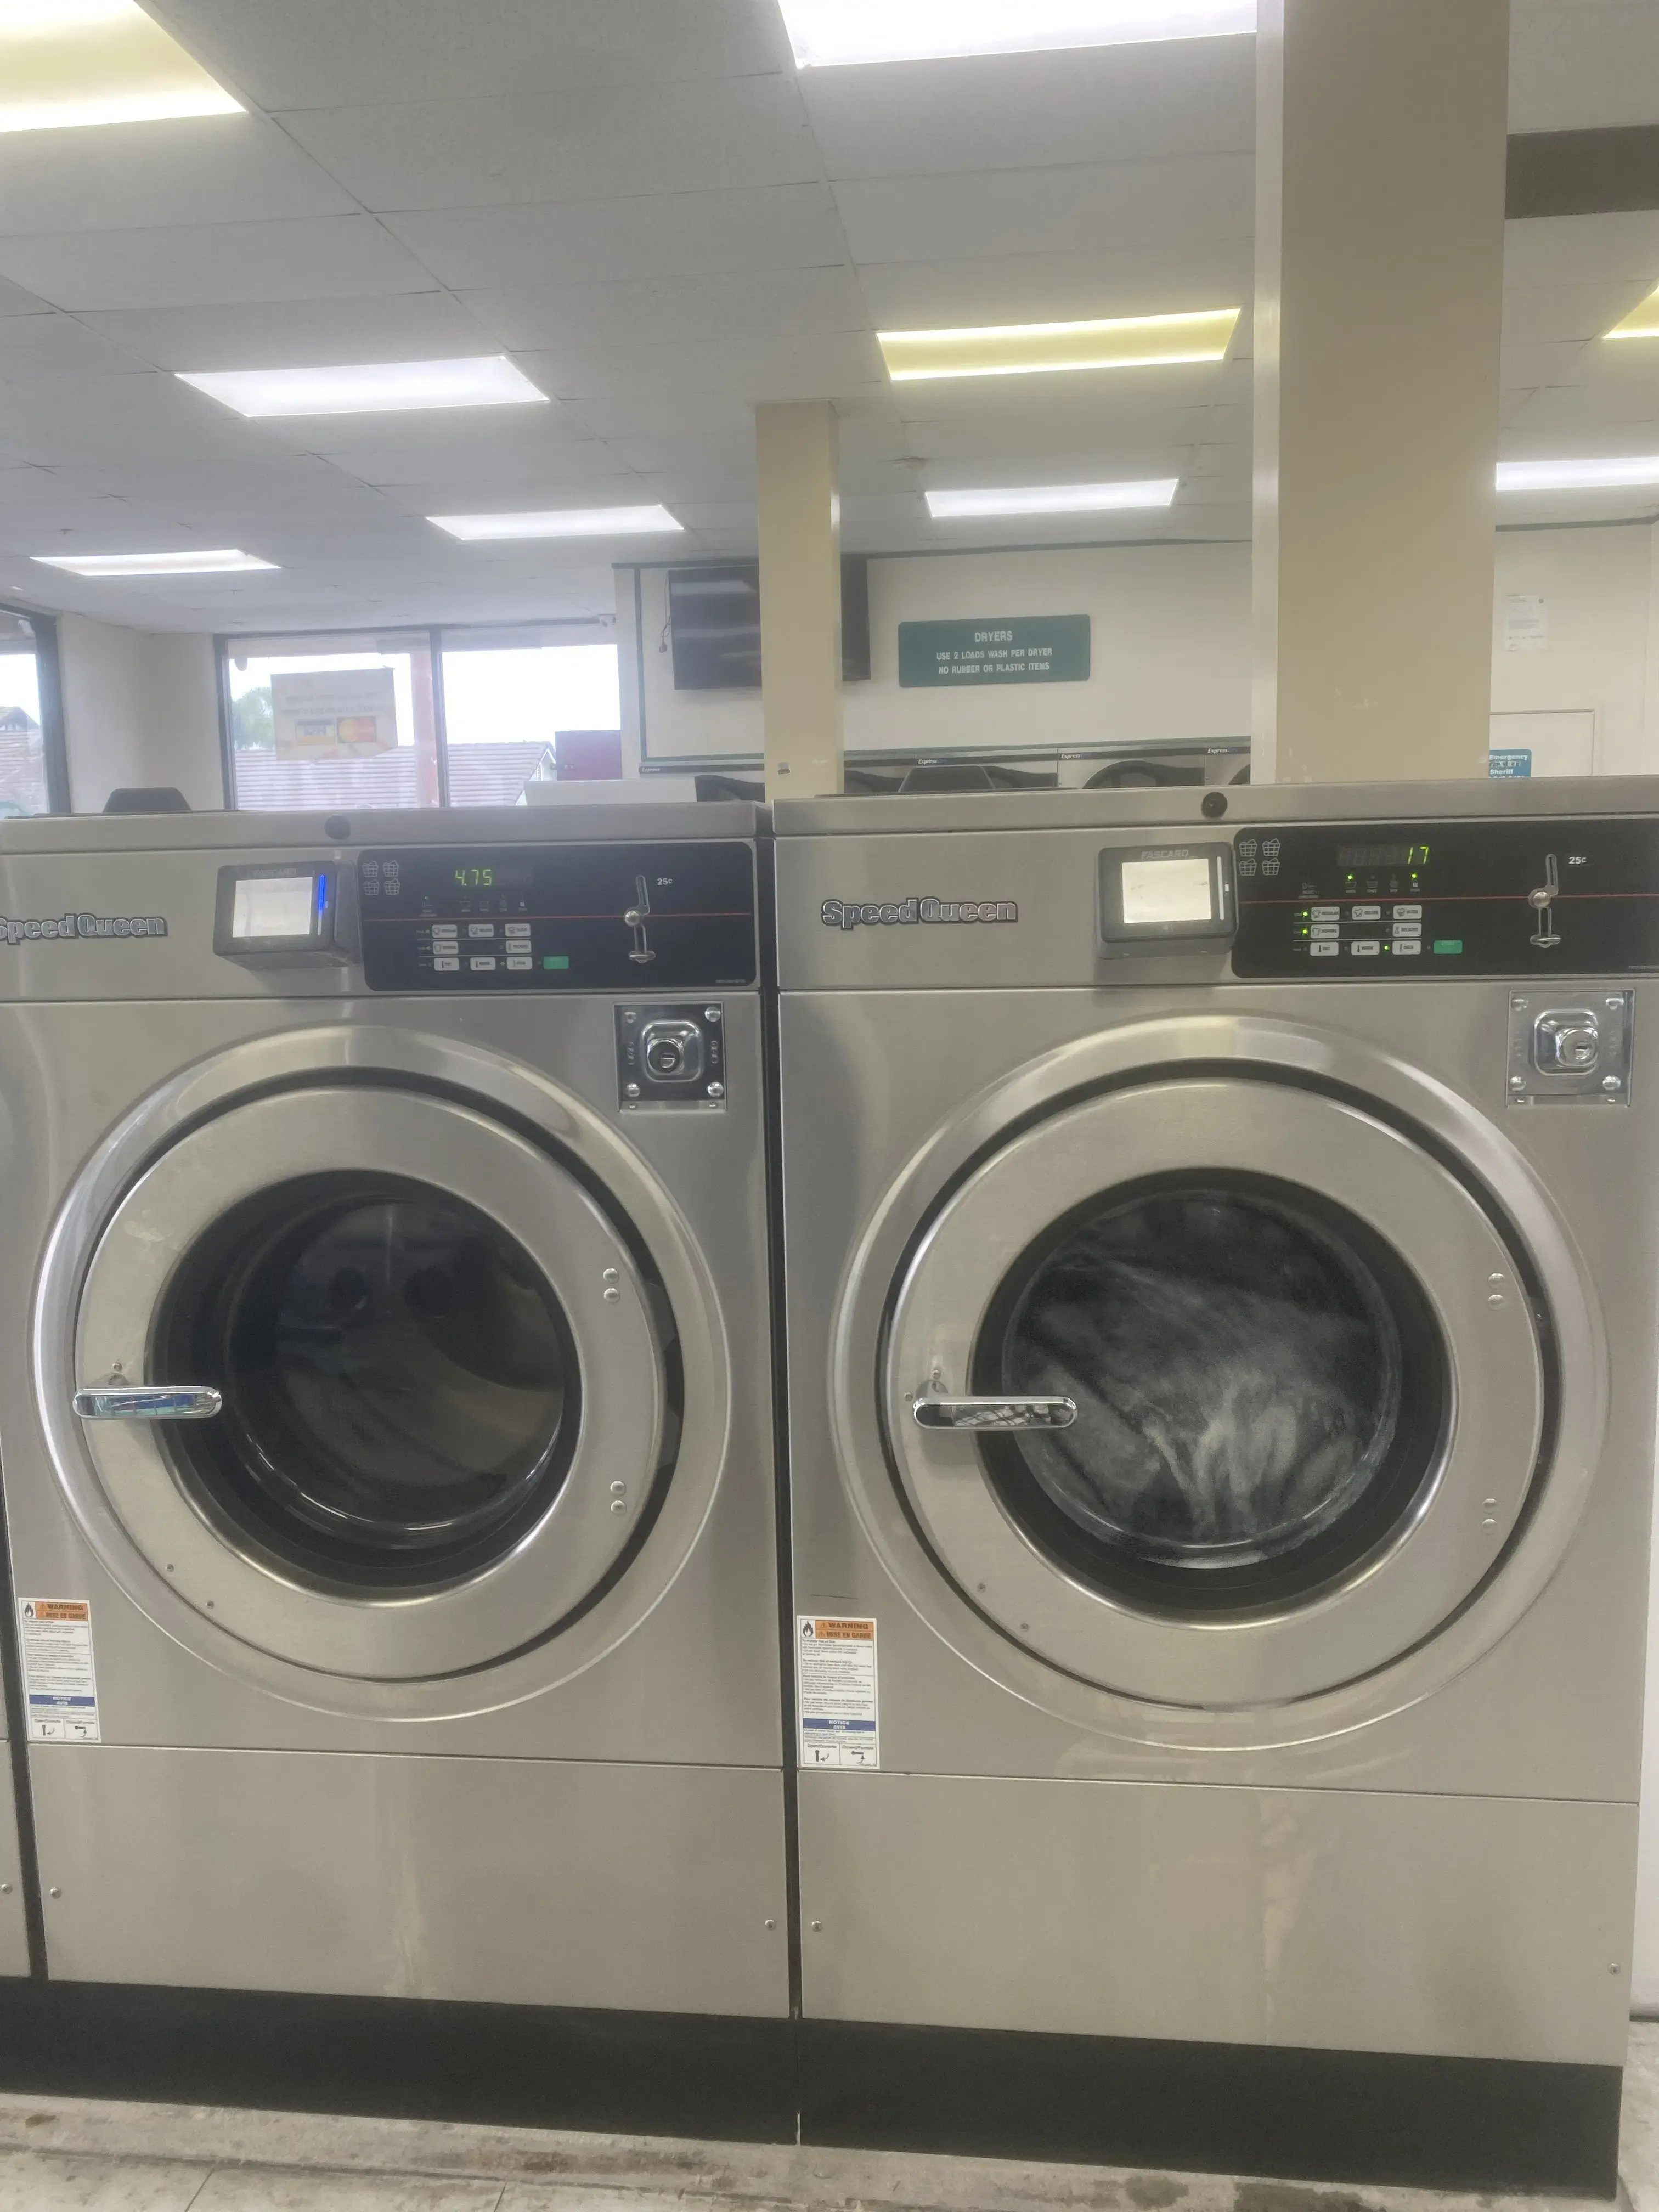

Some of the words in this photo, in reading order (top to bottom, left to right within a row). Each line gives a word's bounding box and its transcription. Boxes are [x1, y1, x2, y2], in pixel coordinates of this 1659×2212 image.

[974, 631, 1013, 643] DRYERS
[936, 652, 950, 661] USE
[954, 651, 958, 660] 2
[962, 650, 985, 660] LOADS
[988, 650, 1008, 659] WASH
[1011, 648, 1025, 658] PER
[1028, 648, 1052, 657] DRYER
[939, 665, 949, 674] NO
[952, 665, 980, 674] RUBBER
[983, 664, 993, 673] OR
[997, 663, 1025, 672] PLASTIC
[1028, 662, 1049, 671] ITEMS
[1407, 847, 1429, 865] 17
[455, 869, 492, 886] 4.75
